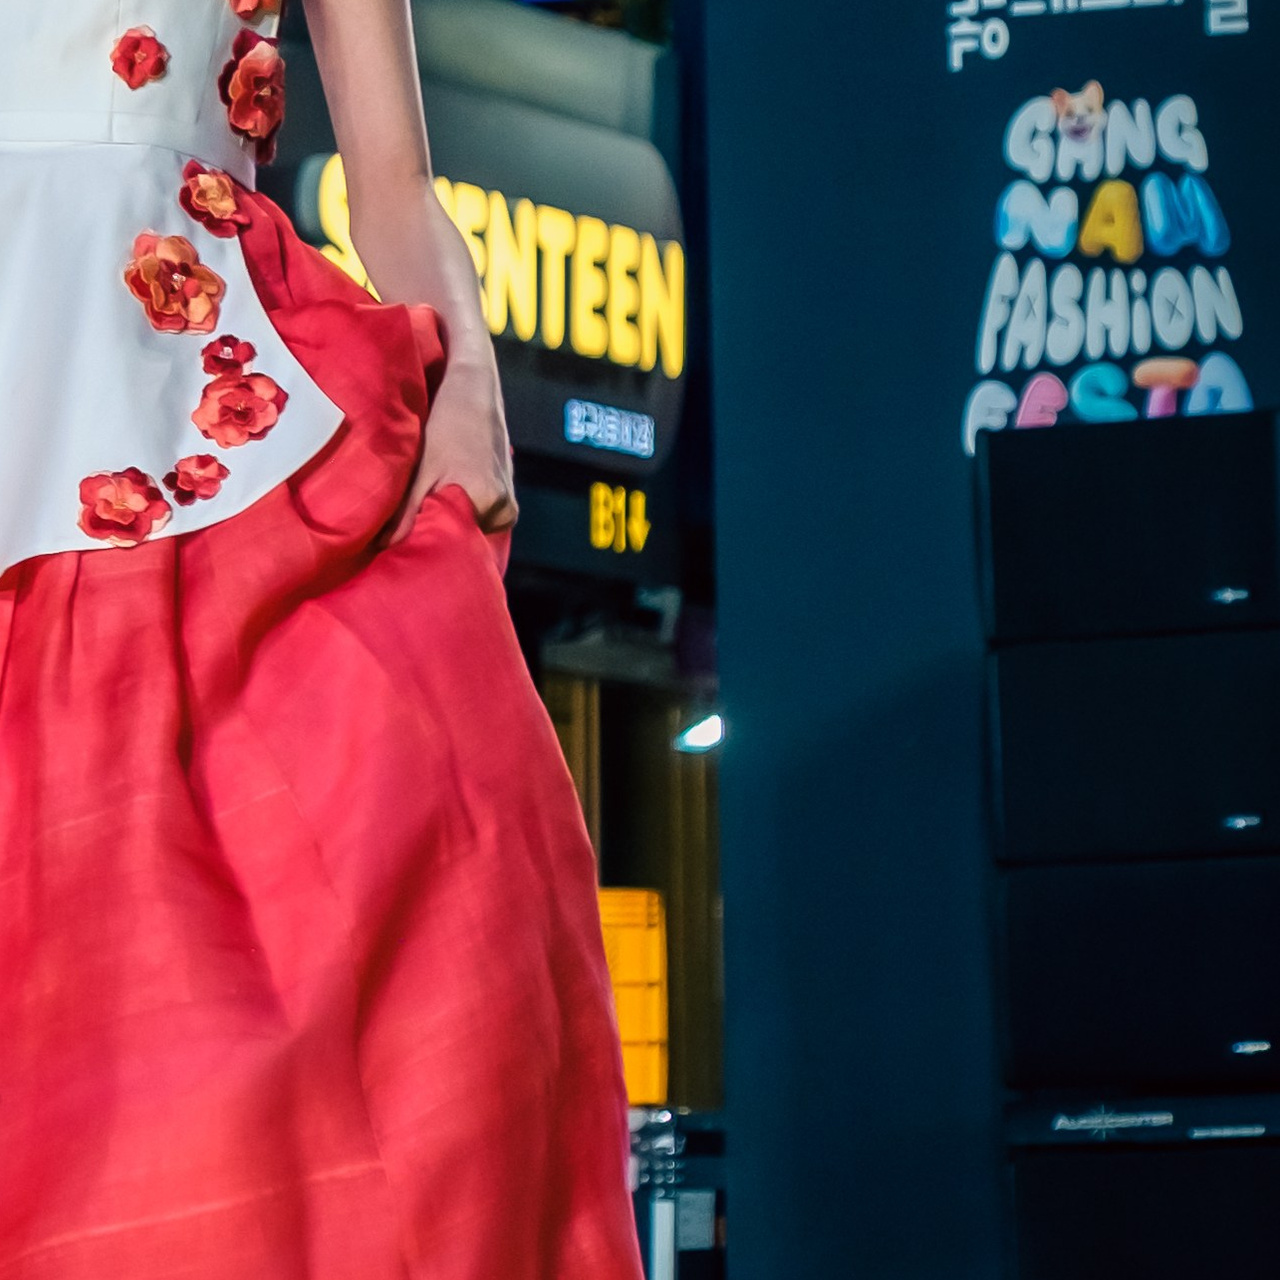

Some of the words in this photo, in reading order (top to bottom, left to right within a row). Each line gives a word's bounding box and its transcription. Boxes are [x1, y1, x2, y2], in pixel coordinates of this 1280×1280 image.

[1003, 86, 1209, 183] GANG
[319, 153, 686, 380] SENTEEN
[994, 172, 1231, 264] NAM
